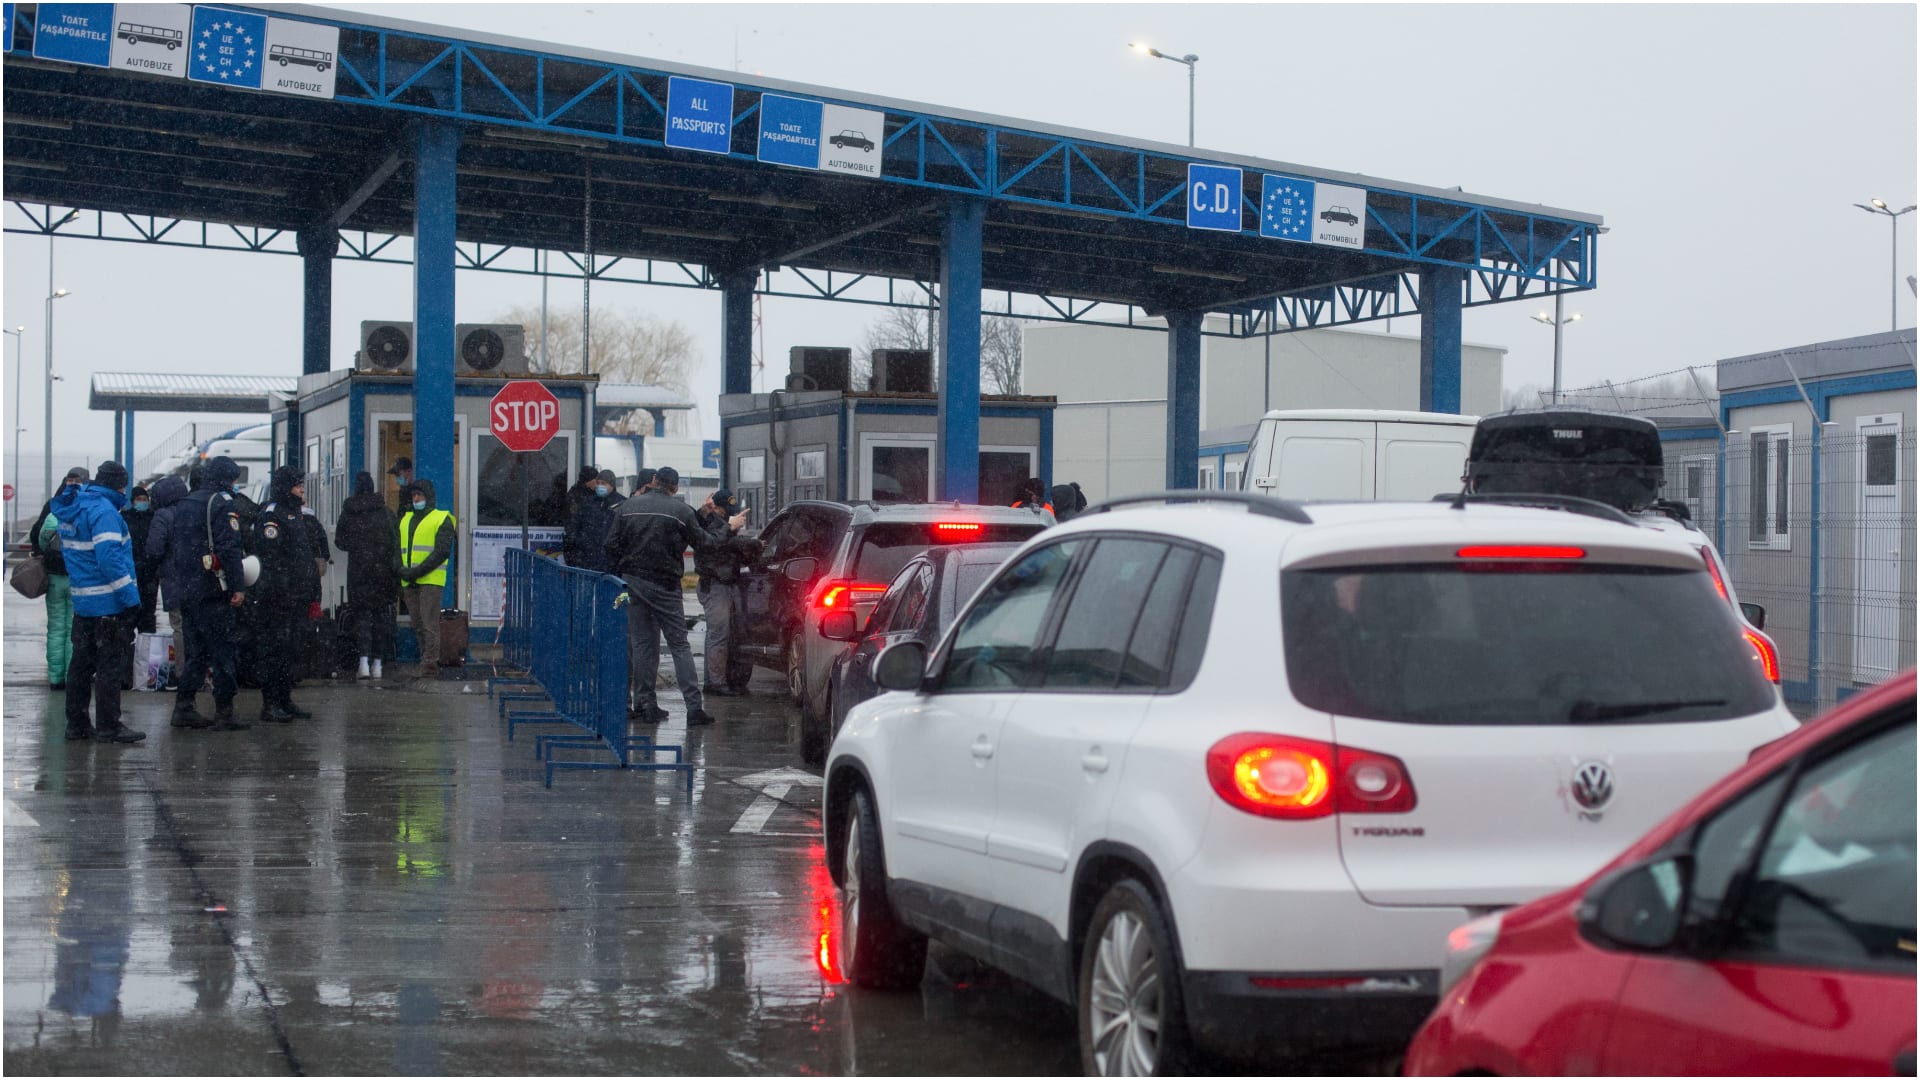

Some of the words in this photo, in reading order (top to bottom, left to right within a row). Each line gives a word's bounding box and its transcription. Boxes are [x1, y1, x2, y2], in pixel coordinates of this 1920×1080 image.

[61, 15, 89, 27] TOATE
[222, 35, 233, 43] UE
[218, 46, 235, 55] SEE
[126, 57, 173, 72] AUTOBUZE
[220, 57, 232, 67] CH
[277, 79, 322, 93] AUTOBUZE
[691, 97, 709, 112] ALL
[672, 117, 725, 135] PASSPORTS
[780, 123, 802, 134] TOATE
[828, 159, 875, 173] AUTOMOBILE
[1193, 182, 1237, 215] C.D.
[1319, 233, 1358, 245] AUTOMOBILE
[494, 400, 556, 432] STOP
[1553, 429, 1582, 438] THULE
